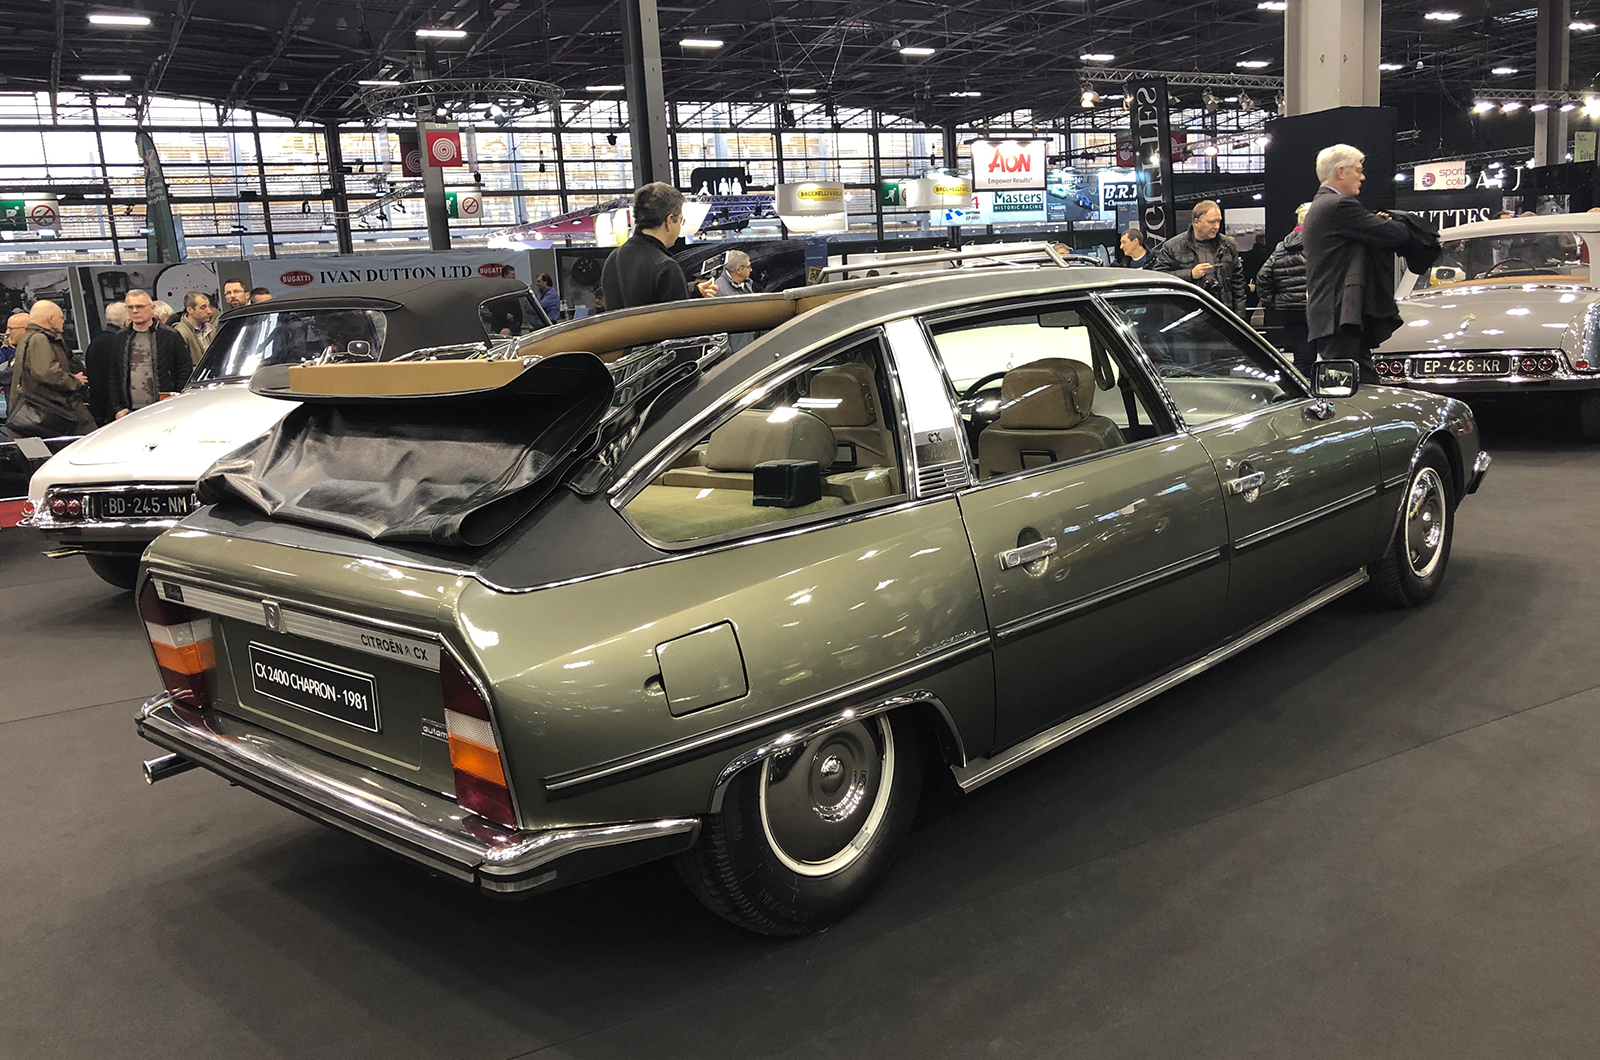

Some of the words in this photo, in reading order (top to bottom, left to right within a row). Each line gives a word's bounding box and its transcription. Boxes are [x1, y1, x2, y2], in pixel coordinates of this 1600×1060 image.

[1439, 168, 1463, 178] sport
[988, 177, 1012, 185] Empower
[994, 191, 1042, 204] Masters
[282, 275, 311, 283] BUGATTI
[320, 269, 361, 284] IVAN
[365, 266, 436, 282] DUTTON
[441, 265, 472, 278] LTD
[1423, 360, 1500, 373] EP-426-KR
[927, 431, 942, 443] CX
[108, 497, 187, 513] BD-245-NM
[361, 634, 404, 655] CITROËN
[413, 646, 429, 661] CX
[255, 662, 268, 680] CX
[268, 666, 290, 686] 2400
[290, 673, 336, 701] CHAPRON
[342, 689, 368, 711] 1981
